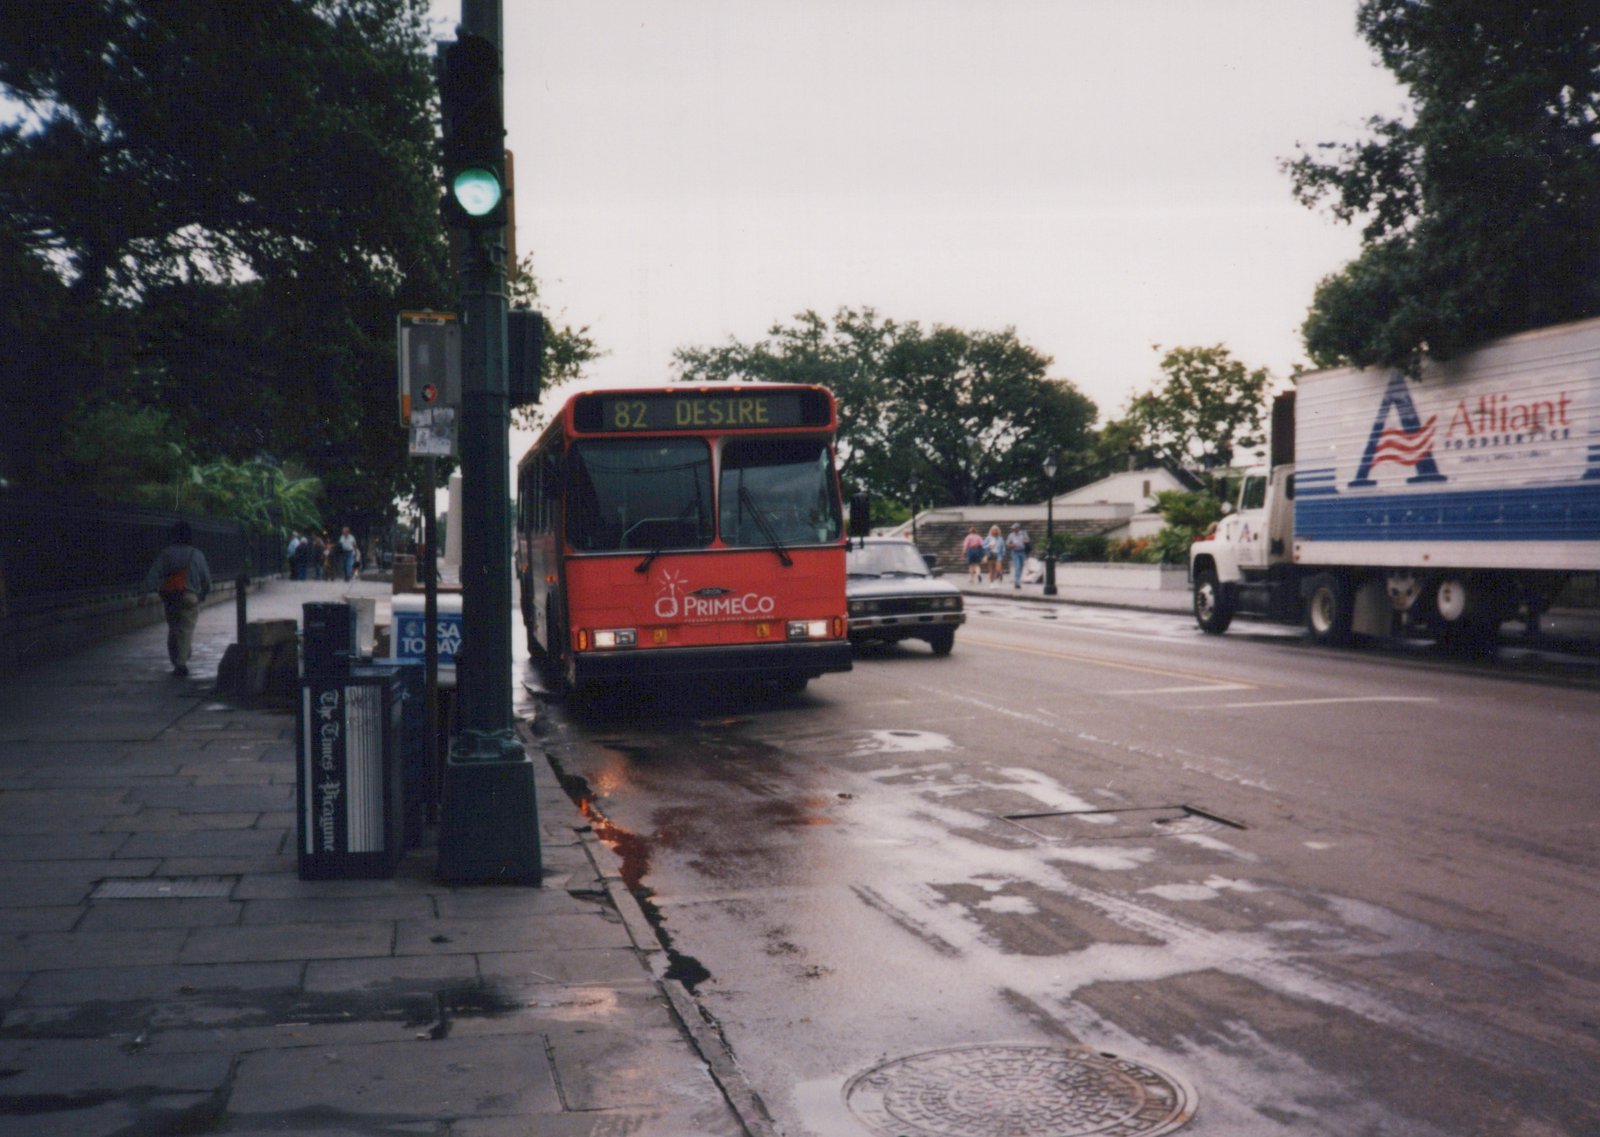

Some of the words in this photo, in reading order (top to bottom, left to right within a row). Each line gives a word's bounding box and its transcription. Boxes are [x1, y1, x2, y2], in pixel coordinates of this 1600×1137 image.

[615, 401, 647, 428] 82
[676, 399, 769, 425] DESIRE
[1446, 390, 1572, 437] Alliant
[1445, 428, 1570, 449] FOODSERCE
[401, 637, 463, 655] TOAY
[317, 689, 340, 720] The
